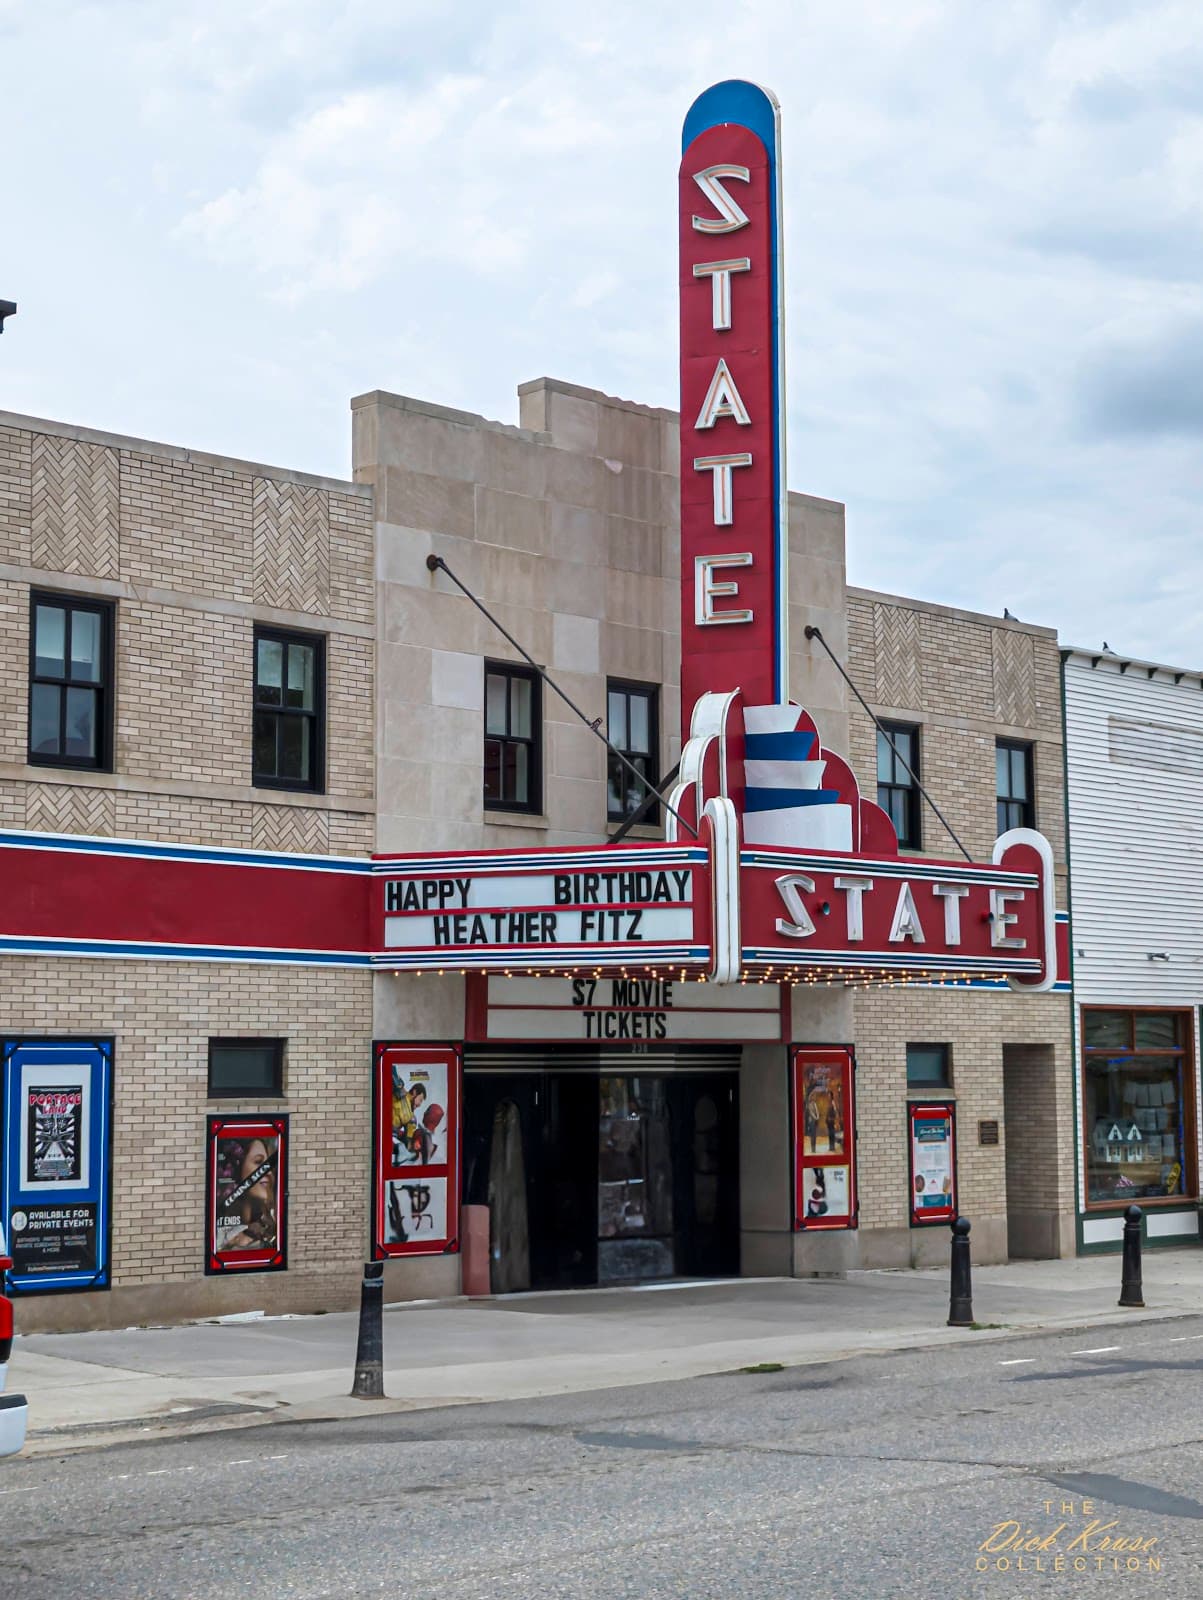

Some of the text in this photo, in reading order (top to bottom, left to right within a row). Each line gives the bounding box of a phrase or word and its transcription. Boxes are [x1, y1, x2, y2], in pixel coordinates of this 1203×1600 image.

[692, 164, 753, 626] STATE
[386, 870, 691, 911] HAPPY BIRTHDAY
[774, 873, 1027, 949] STATE
[433, 909, 643, 946] HEATHER FITZ
[612, 979, 674, 1007] MOVIE
[582, 1011, 667, 1039] TICKETS
[29, 1093, 82, 1106] PORTAGE
[224, 1163, 271, 1207] COMING SOON
[29, 1210, 89, 1220] AVAILABLE FOR
[29, 1219, 94, 1229] PRIVATE EVENTS
[224, 1215, 241, 1226] ENDS
